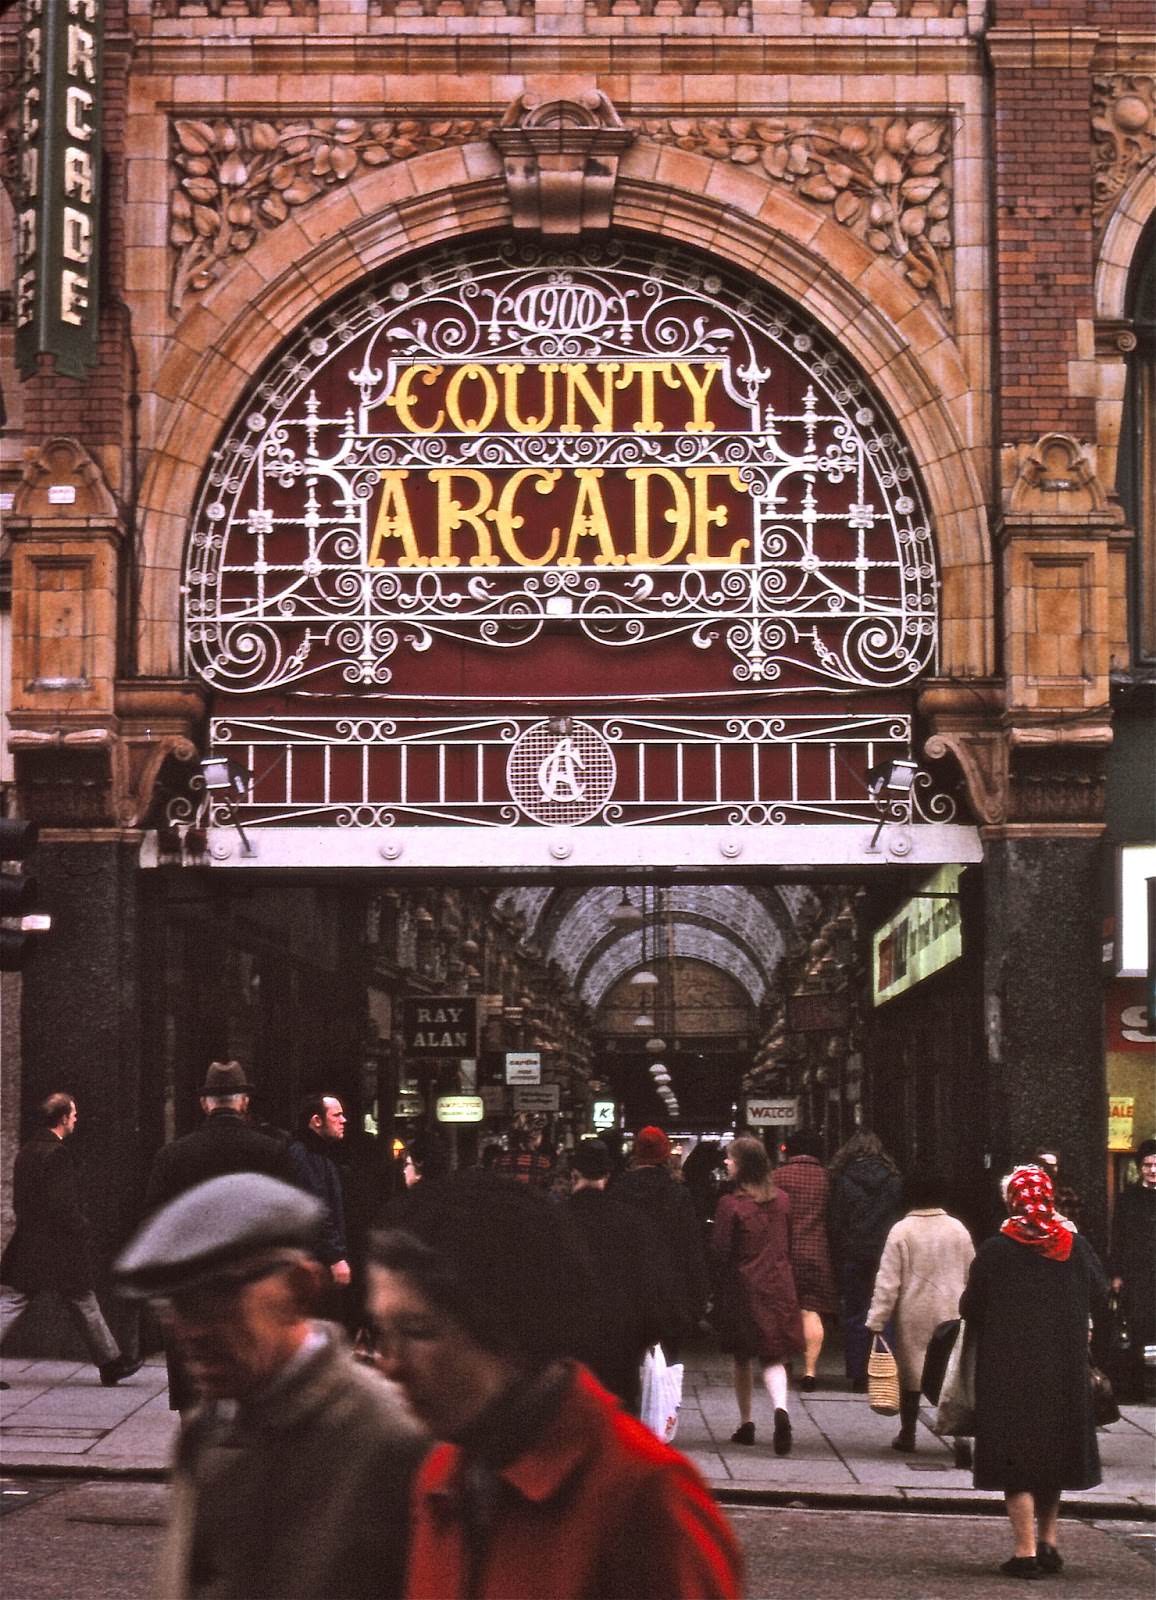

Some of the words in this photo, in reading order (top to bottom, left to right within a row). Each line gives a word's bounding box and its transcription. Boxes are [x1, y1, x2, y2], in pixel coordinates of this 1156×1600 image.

[526, 287, 596, 330] 1900
[386, 362, 723, 433] COUNTY
[367, 468, 750, 567] ARCADE
[417, 1008, 463, 1023] RAY
[413, 1032, 467, 1047] ALAN
